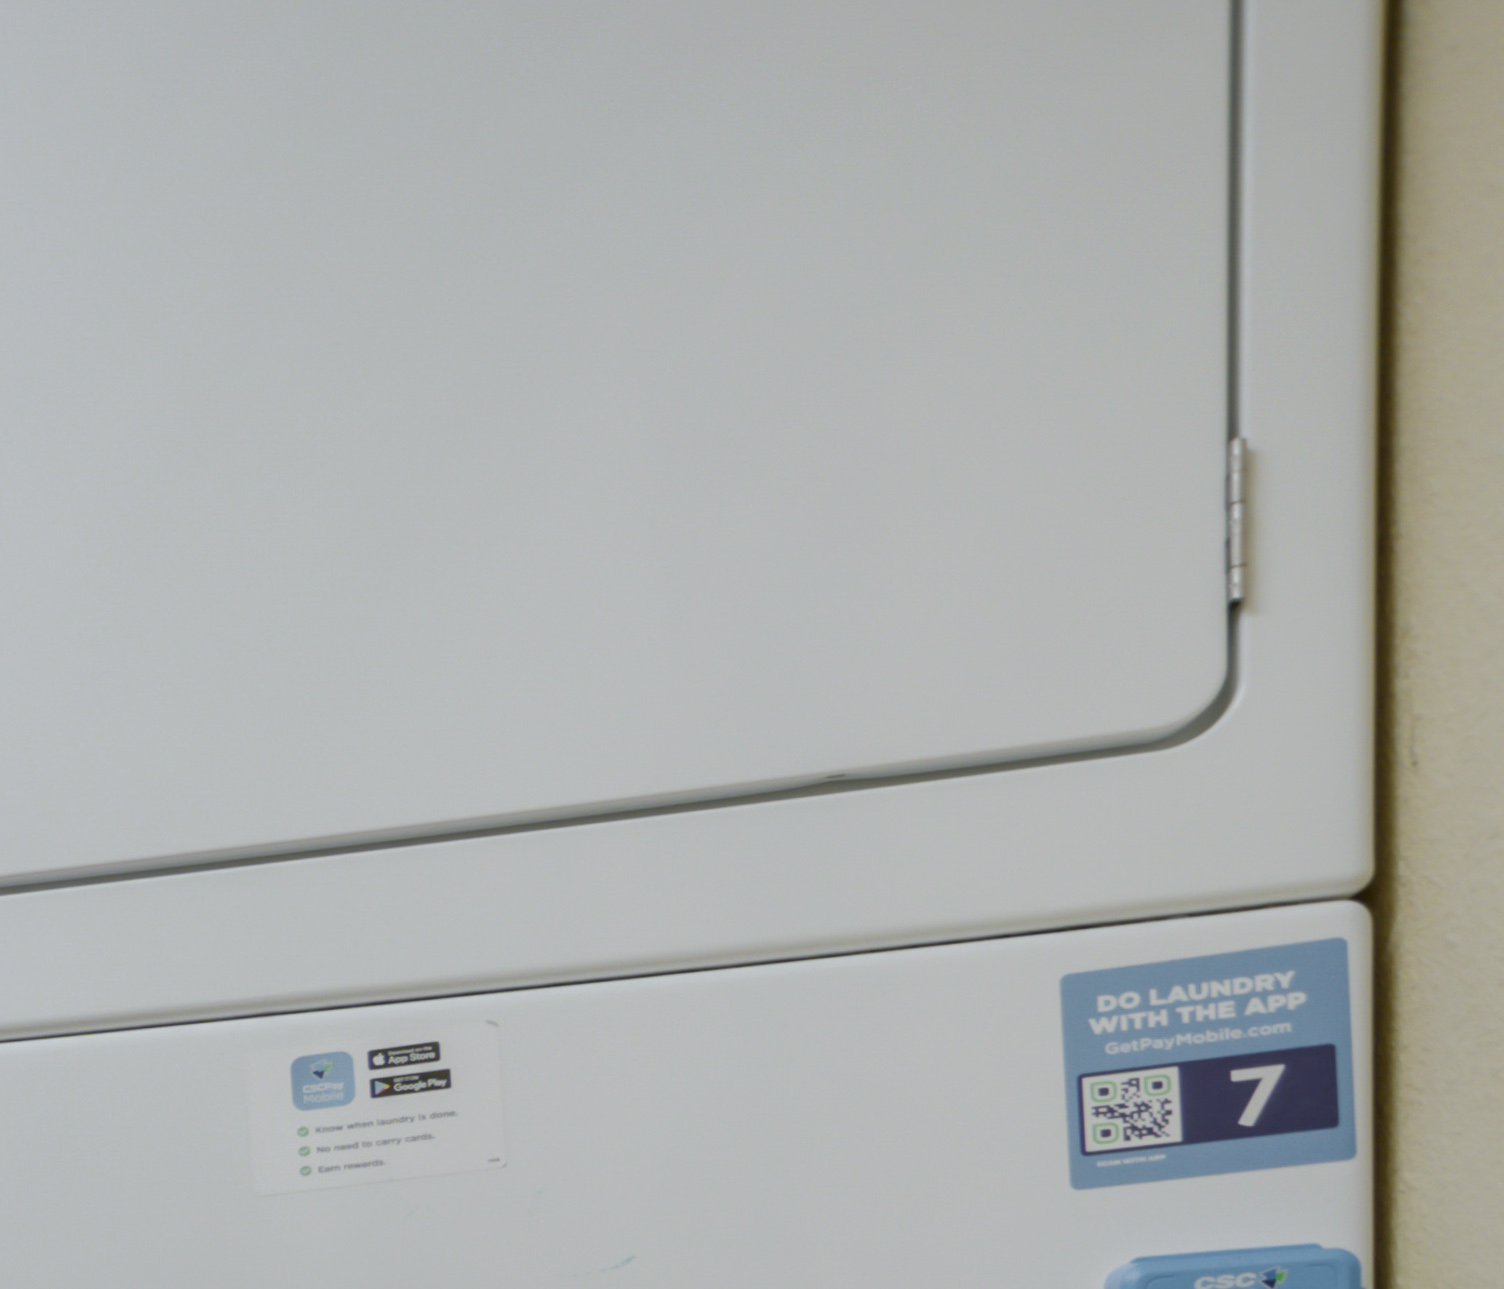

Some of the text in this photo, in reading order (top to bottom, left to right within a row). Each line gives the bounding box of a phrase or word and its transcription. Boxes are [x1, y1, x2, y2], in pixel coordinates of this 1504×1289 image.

[1097, 970, 1296, 1012] DO LAUNDRY
[1088, 992, 1308, 1035] WITH THE APP
[1105, 1022, 1292, 1055] GetPayMobile.com
[388, 1055, 408, 1065] App
[410, 1051, 435, 1061] Store
[393, 1080, 426, 1092] Google
[428, 1078, 447, 1089] Play
[1230, 1064, 1286, 1127] 7
